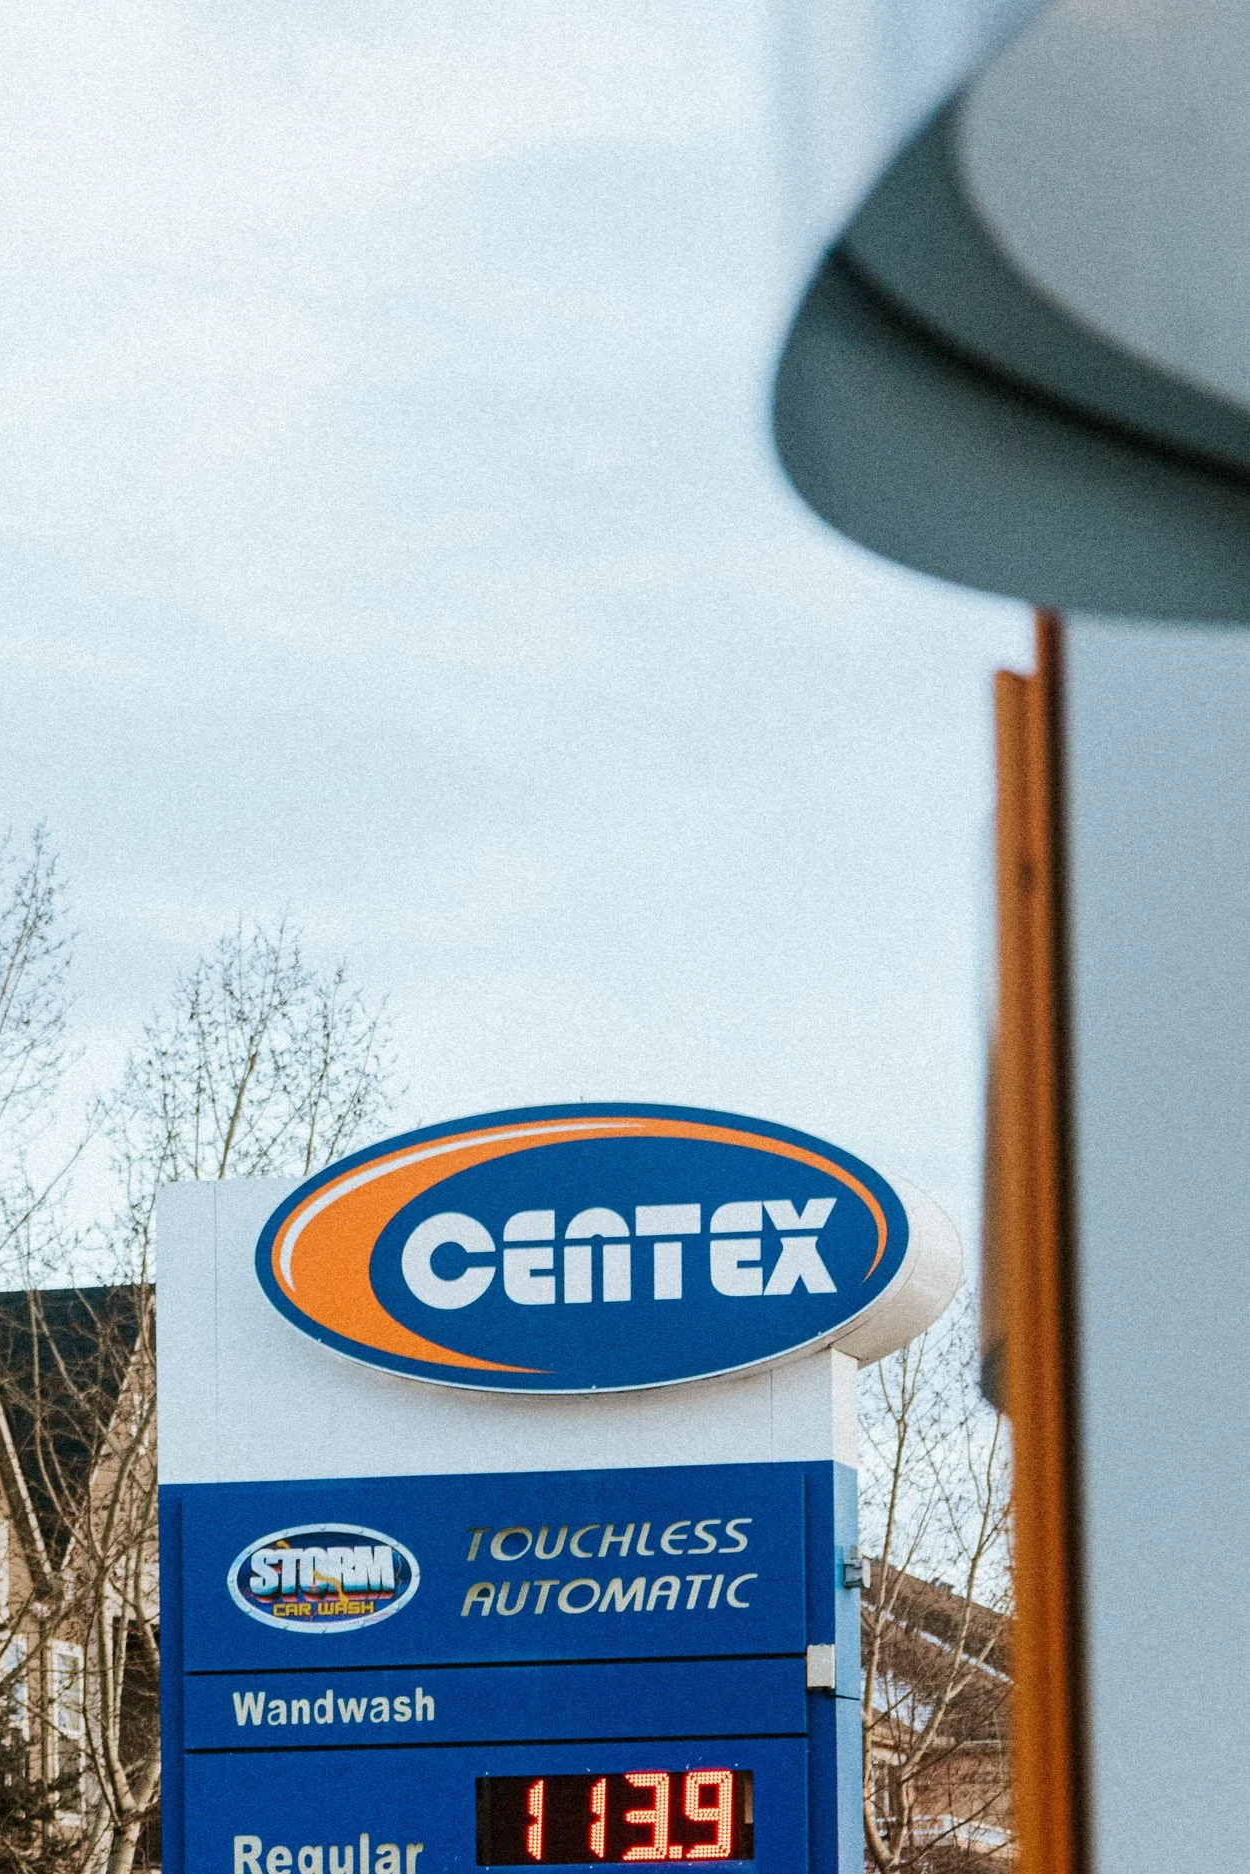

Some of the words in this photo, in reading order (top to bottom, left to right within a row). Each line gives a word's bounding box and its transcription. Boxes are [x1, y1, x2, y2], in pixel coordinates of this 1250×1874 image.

[400, 1197, 838, 1311] CENTEX
[468, 1518, 753, 1562] TOUCHLESS
[250, 1545, 395, 1598] STORM
[273, 1602, 312, 1617] CAR
[317, 1600, 376, 1616] WASH
[462, 1573, 758, 1617] AUTOMATIC
[232, 1687, 436, 1727] Wandwash
[527, 1770, 734, 1862] 113.9
